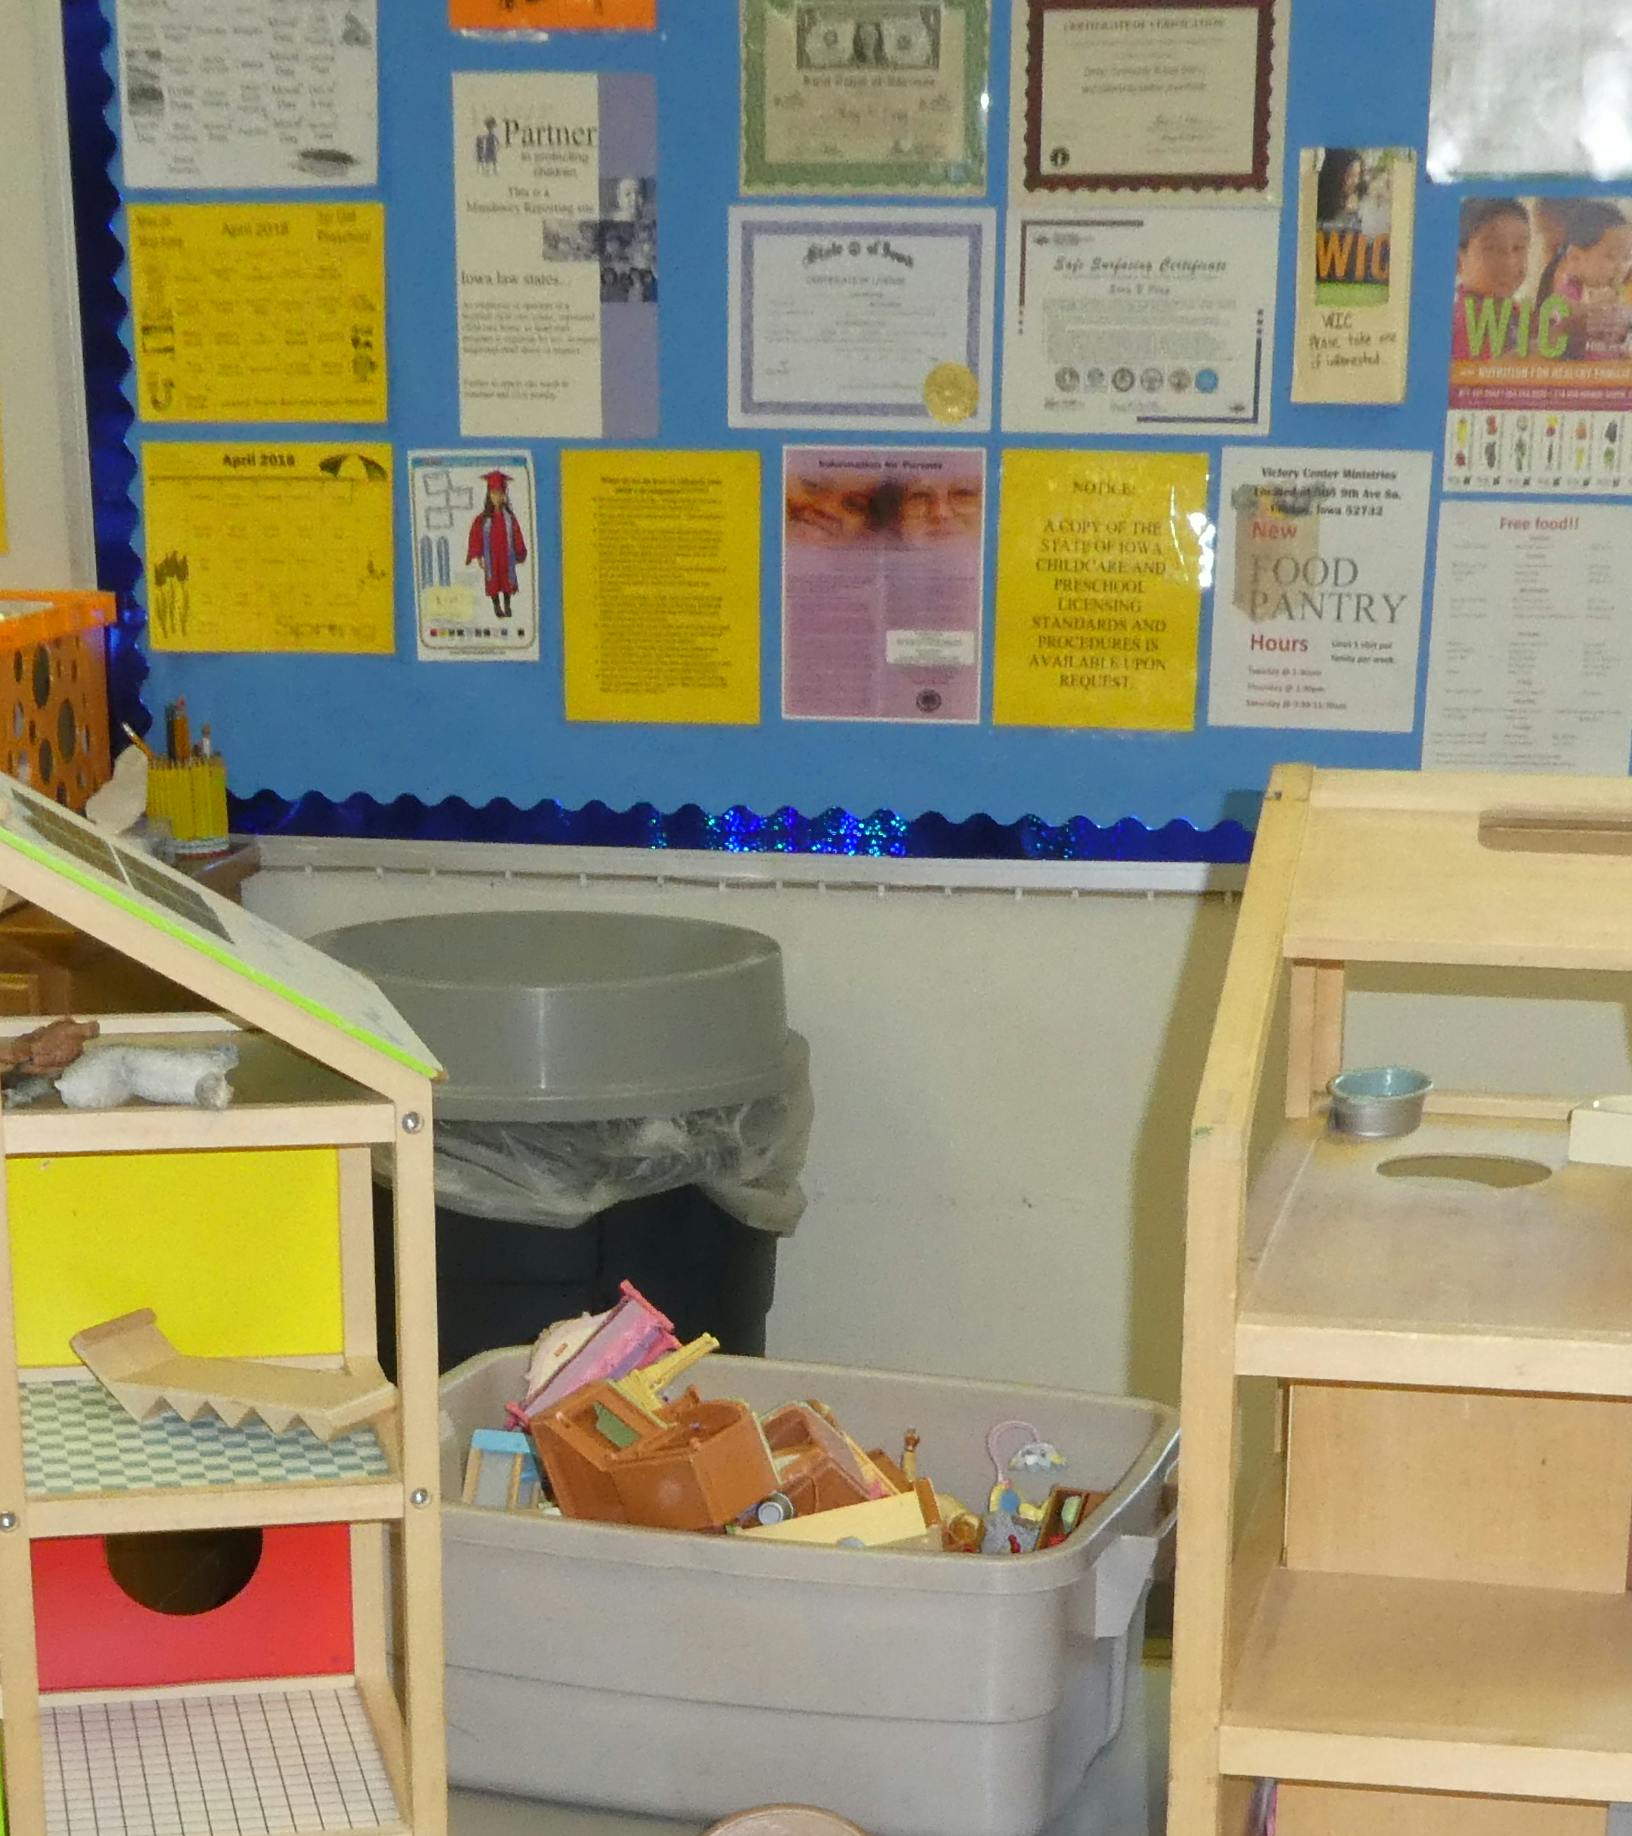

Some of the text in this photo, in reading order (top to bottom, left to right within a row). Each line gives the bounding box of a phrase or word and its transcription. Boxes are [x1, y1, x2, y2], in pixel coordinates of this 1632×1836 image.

[503, 117, 597, 147] Partner
[1315, 228, 1389, 282] WIC
[1465, 295, 1573, 358] WIC
[222, 453, 257, 469] April
[1261, 467, 1398, 480] Victory Center Ministries
[1340, 488, 1360, 499] 9th
[1043, 519, 1162, 536] A COPY OF THE
[1251, 520, 1298, 540] New
[1499, 516, 1580, 531] Free food!!
[1041, 538, 1090, 553] STATE
[1119, 540, 1163, 555] IOWA
[1035, 558, 1166, 575] CHILDCARE AND
[1251, 554, 1359, 588] FOOD
[1054, 578, 1145, 593] PRESCHOOL
[1057, 597, 1142, 613] LICENSING
[1249, 590, 1408, 624] PANTRY
[1032, 616, 1167, 632] STANDARDS AND
[1038, 635, 1159, 651] PROCEDURES IS
[1250, 633, 1309, 652] Hours
[1029, 654, 1166, 670] AVAILABLE UPON
